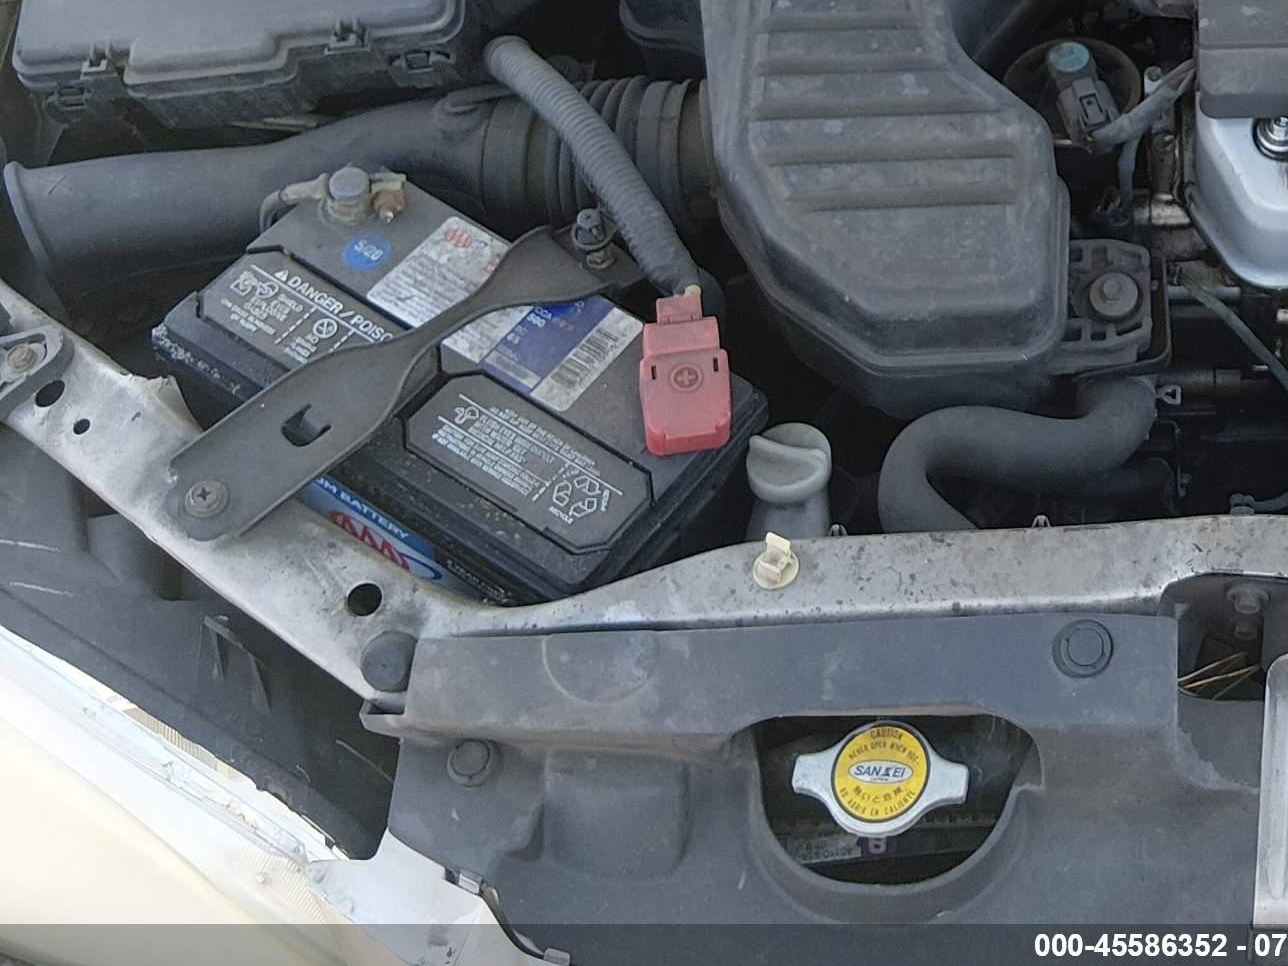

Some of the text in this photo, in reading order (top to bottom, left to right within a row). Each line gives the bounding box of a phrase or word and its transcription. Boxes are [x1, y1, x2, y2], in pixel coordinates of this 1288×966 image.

[288, 275, 344, 314] DANGER
[350, 314, 394, 342] POISO
[340, 489, 410, 540] BATTERY
